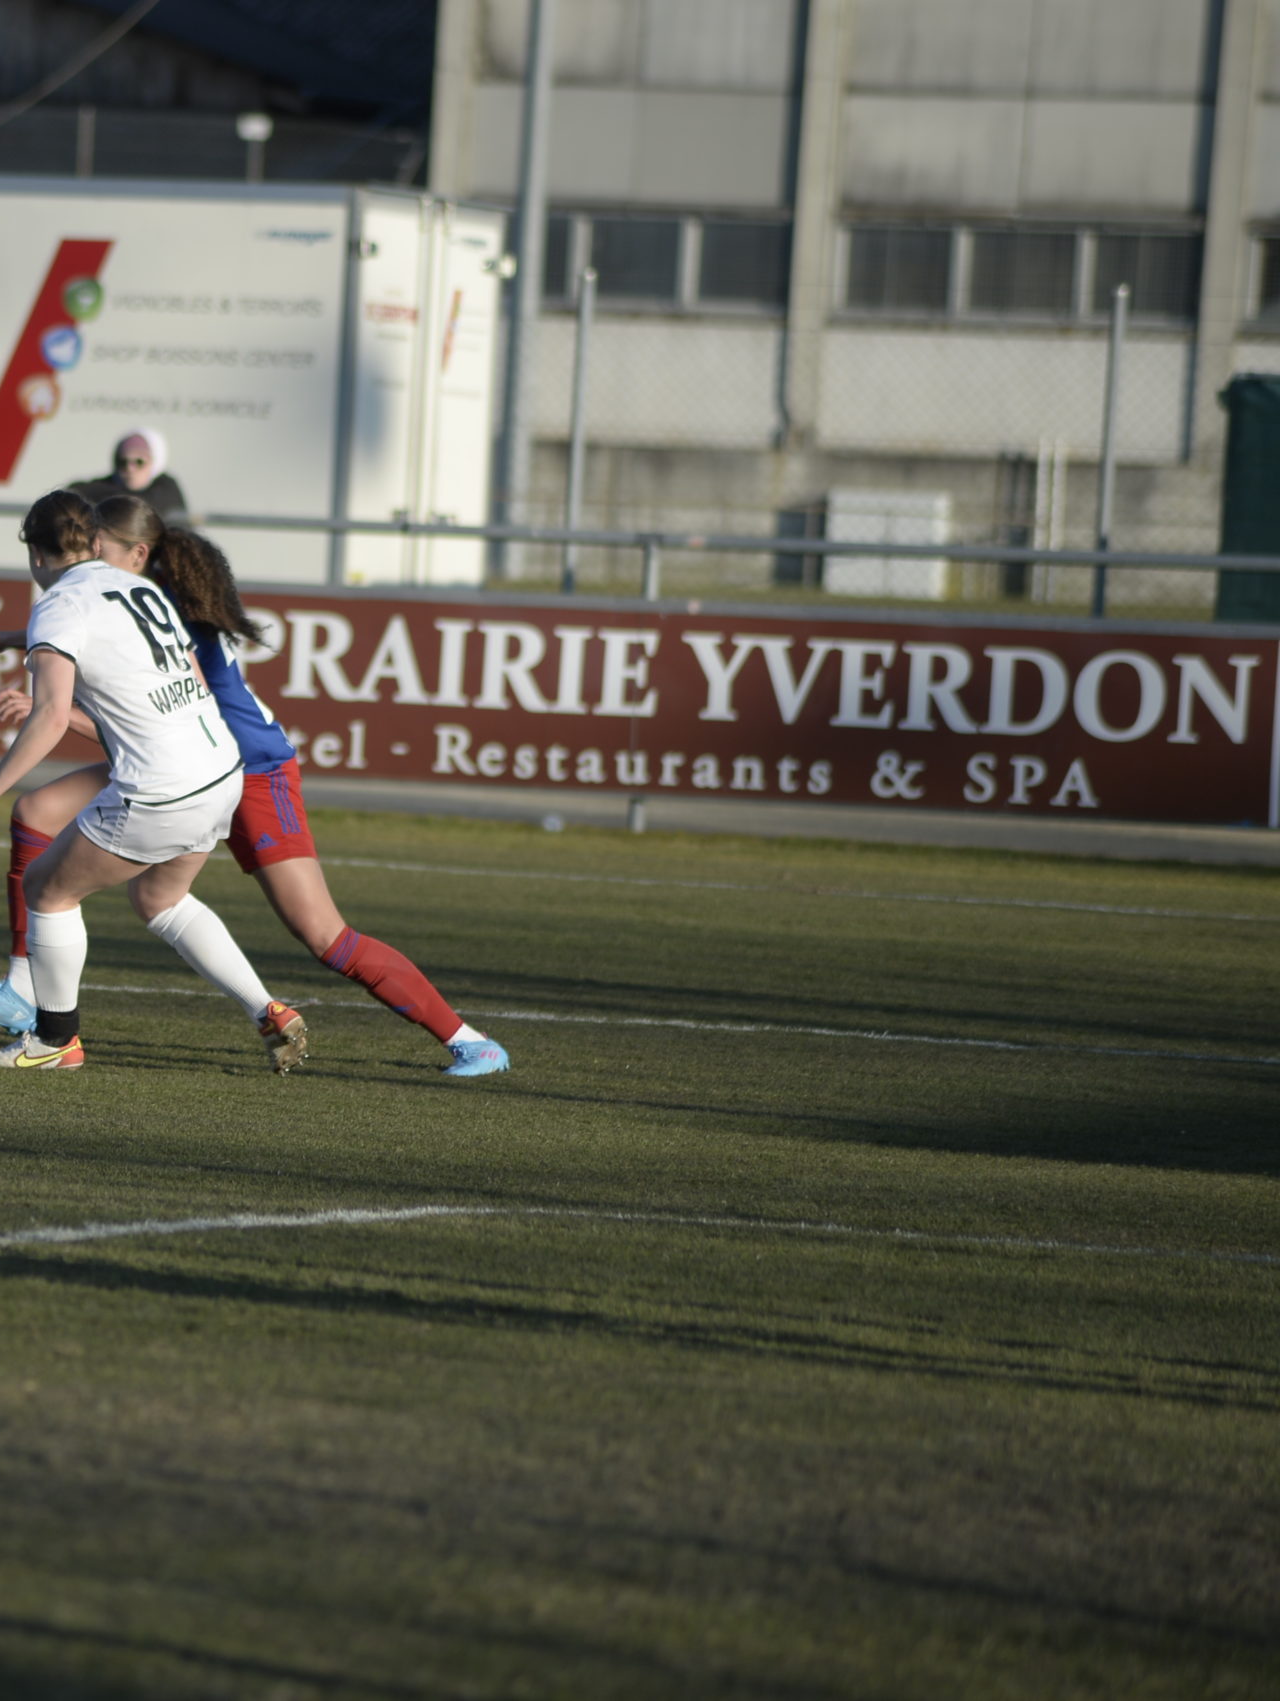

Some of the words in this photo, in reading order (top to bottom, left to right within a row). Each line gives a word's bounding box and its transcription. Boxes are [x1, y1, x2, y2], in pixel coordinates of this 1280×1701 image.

[241, 607, 660, 718] PRAIRIE
[682, 631, 1260, 744] YVERDON
[433, 724, 832, 796] Restaurants
[870, 750, 925, 800] &
[964, 753, 1100, 808] SPA
